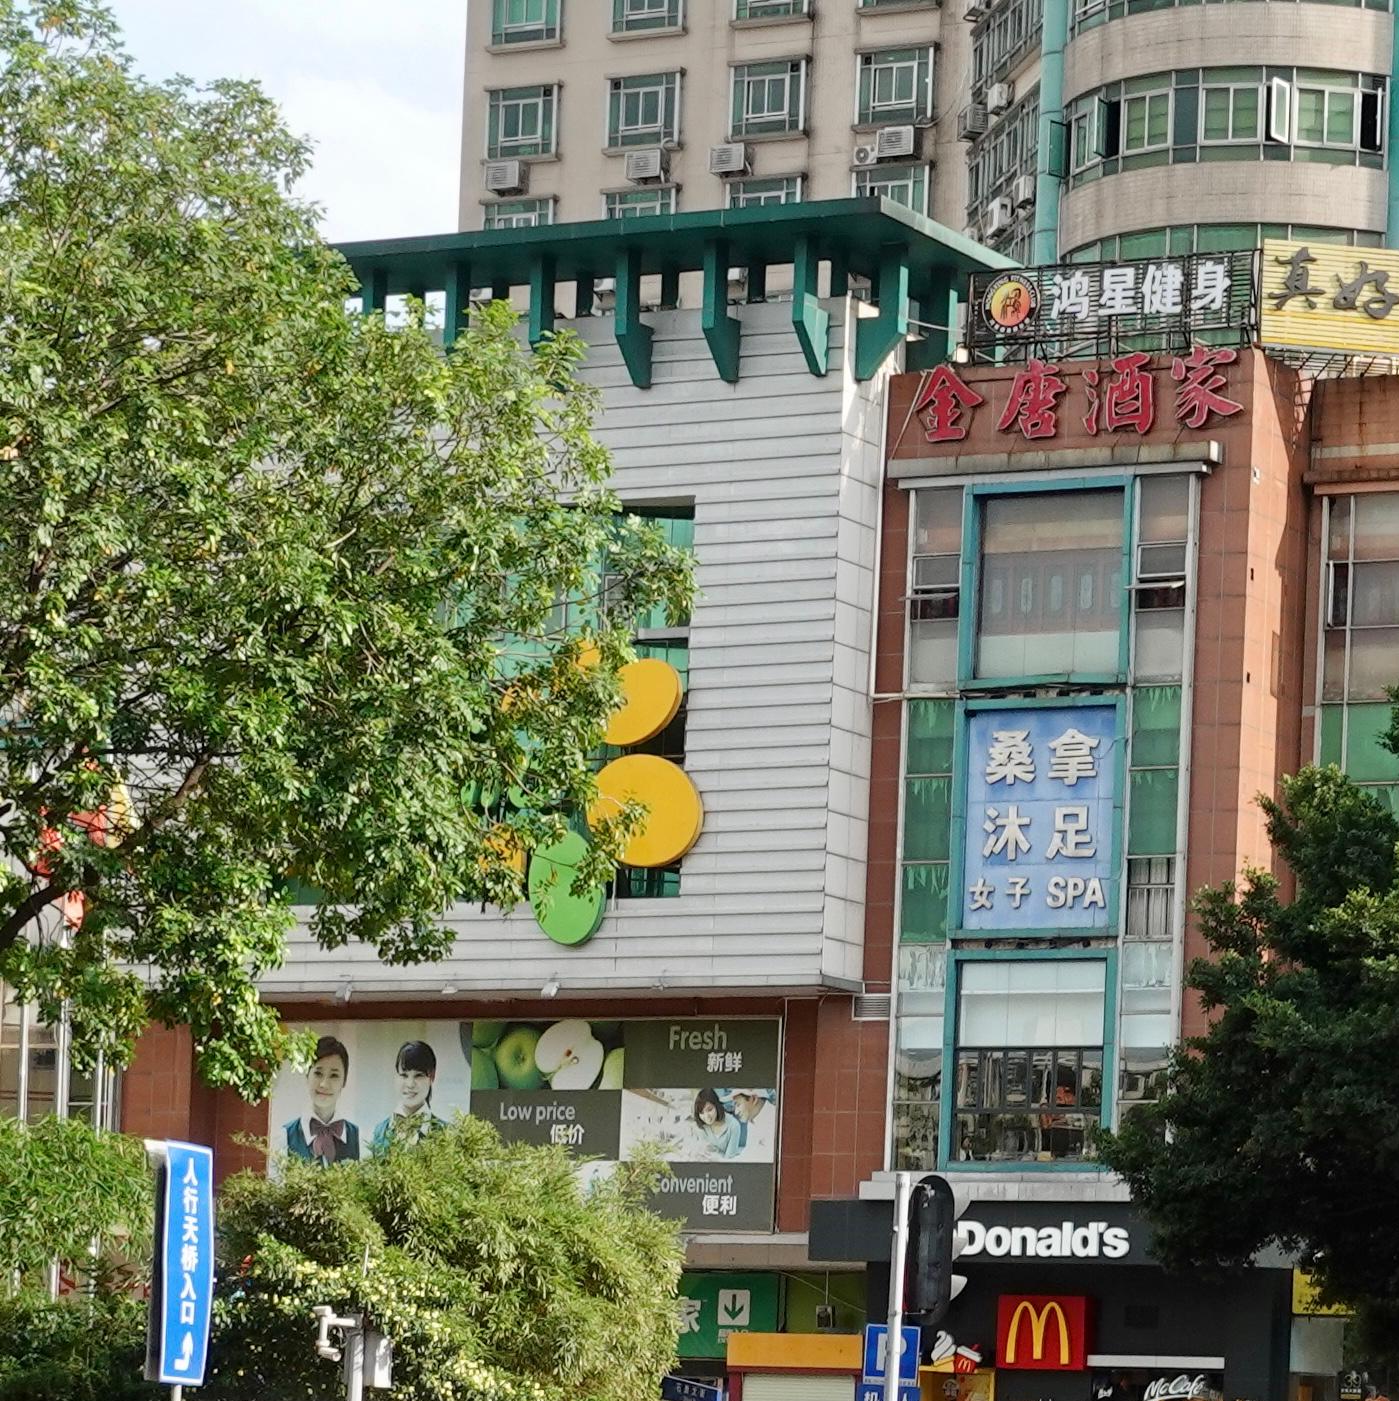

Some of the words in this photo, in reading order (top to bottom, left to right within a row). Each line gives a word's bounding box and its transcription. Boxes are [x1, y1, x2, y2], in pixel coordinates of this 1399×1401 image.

[1050, 262, 1231, 320] 鸿星健身
[915, 346, 1245, 442] 金唐酒家
[985, 728, 1101, 786] 桑拿
[982, 805, 1098, 861] 沐足
[969, 877, 1032, 911] 女子
[1046, 875, 1107, 909] SPA
[668, 1023, 728, 1051] Fresh
[706, 1051, 743, 1073] 新鲜
[499, 1102, 533, 1121] Low
[535, 1102, 576, 1126] price
[549, 1124, 586, 1146] 低价
[650, 1173, 735, 1195] Convenient
[701, 1195, 738, 1216] 便利
[180, 1157, 199, 1326] 人行天桥入口
[957, 1220, 1131, 1259] Donald's
